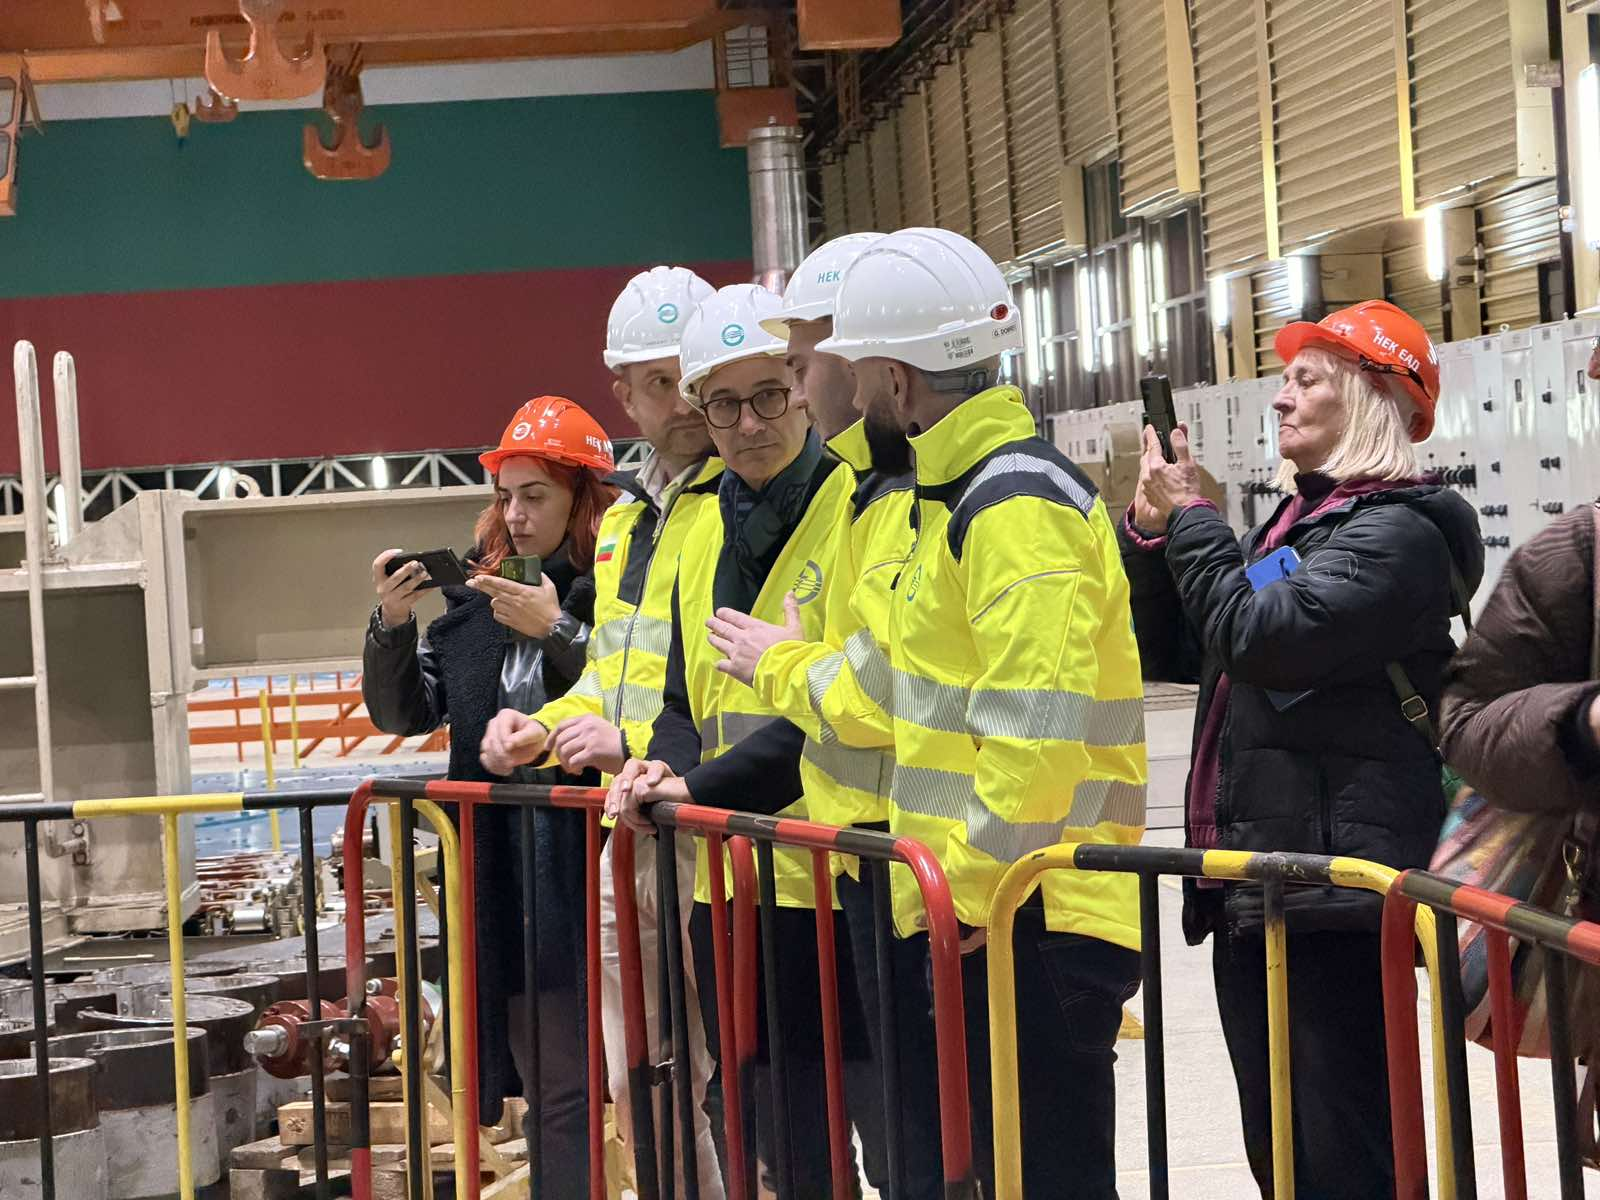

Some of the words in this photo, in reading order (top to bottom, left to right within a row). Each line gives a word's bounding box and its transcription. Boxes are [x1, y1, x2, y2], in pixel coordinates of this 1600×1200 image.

[817, 271, 840, 283] НЕК
[1373, 333, 1399, 351] НЕК
[1398, 349, 1420, 372] ЕАД
